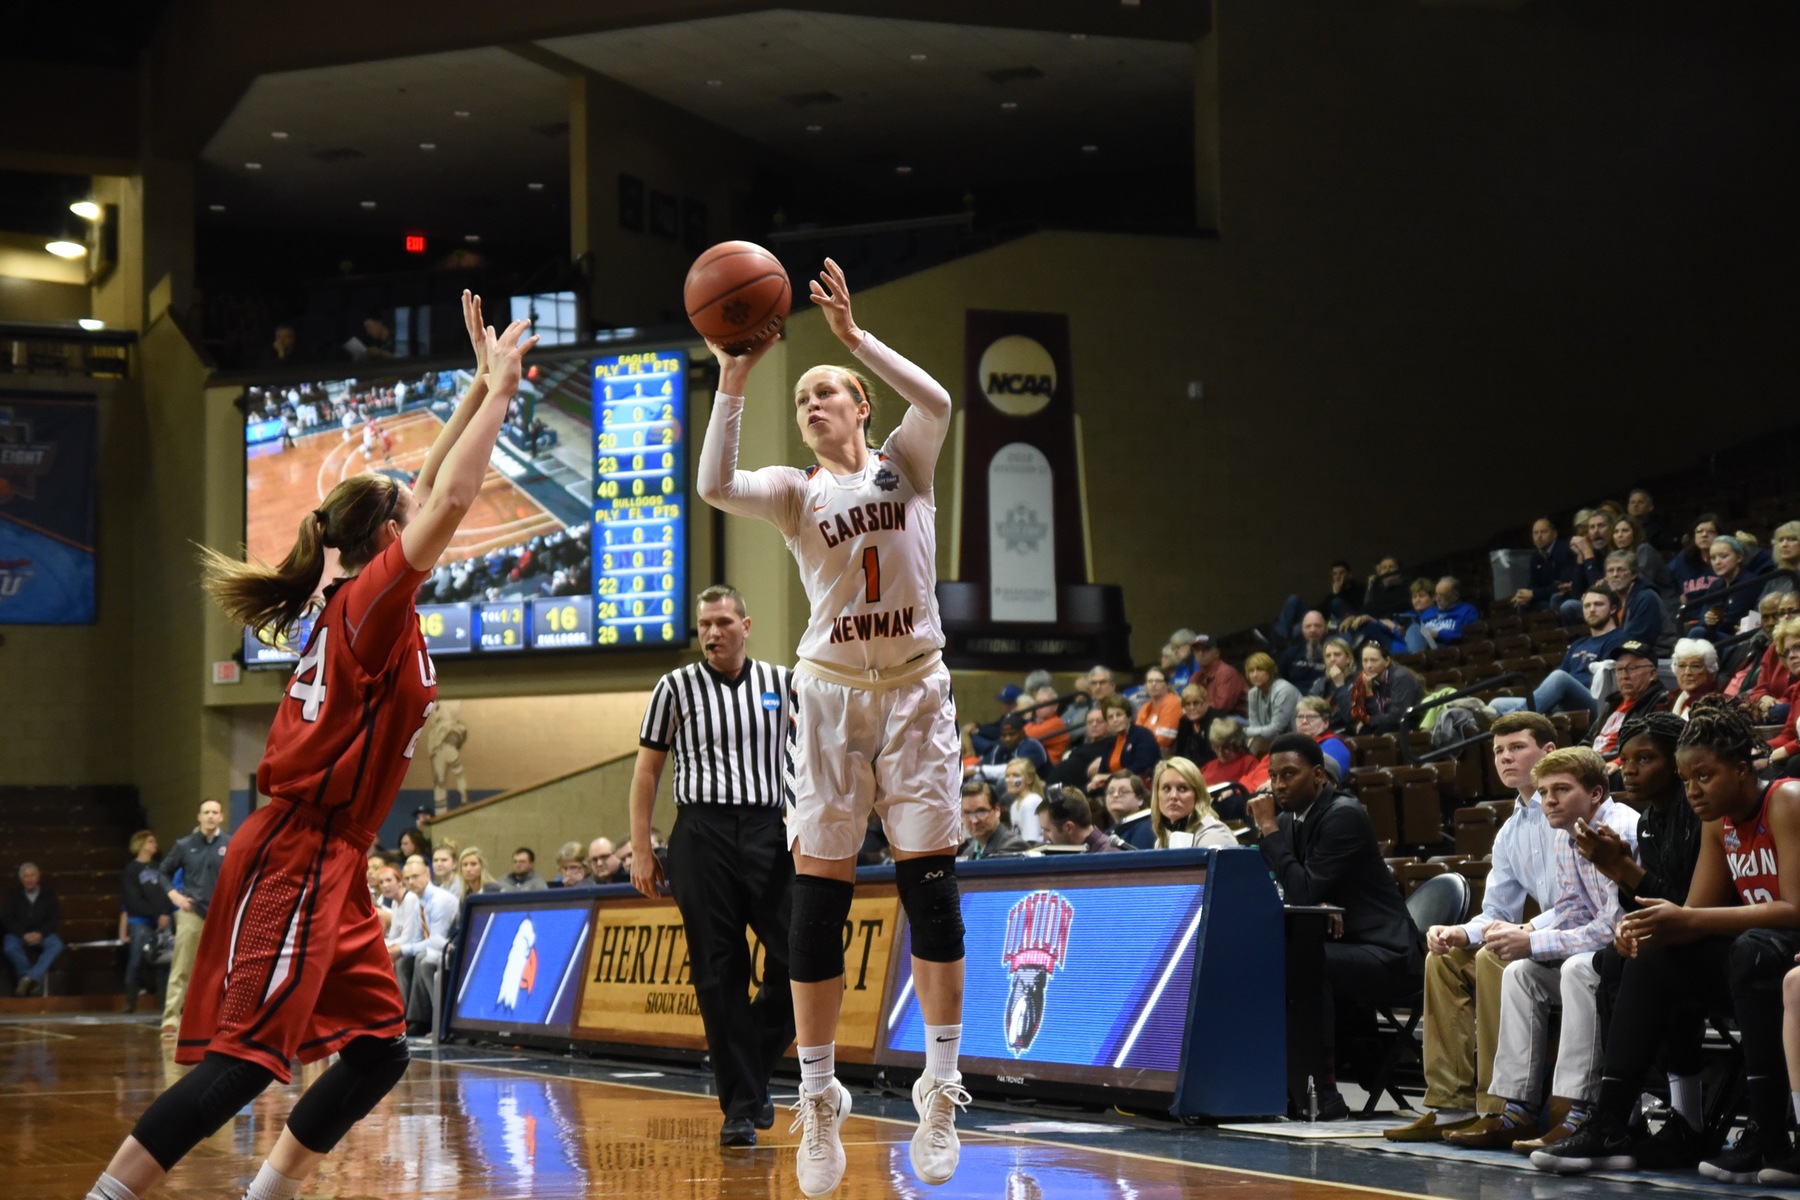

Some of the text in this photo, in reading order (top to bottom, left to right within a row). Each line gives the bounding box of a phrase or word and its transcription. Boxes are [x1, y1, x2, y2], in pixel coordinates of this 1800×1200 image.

[595, 358, 679, 378] PLY FL PTS
[619, 352, 656, 365] EAGLES
[604, 380, 673, 400] 1 1 4
[987, 372, 1052, 396] NCAA
[603, 403, 673, 425] 2 0 2
[598, 427, 673, 450] 20 0 2
[1, 450, 45, 465] EIGHT
[598, 451, 674, 474] 23 0 0
[597, 476, 674, 498] 40 0 0
[612, 494, 663, 509] BULLDOGS
[595, 504, 679, 523] PLY FL PTS
[604, 525, 673, 545] 1 0 2
[818, 502, 906, 548] CARSON
[603, 549, 673, 570] 3 0 2
[598, 573, 674, 595] 22 0 0
[862, 546, 880, 604] 1
[546, 606, 578, 631] 16
[598, 598, 674, 619] 24 0 0
[598, 622, 674, 644] 25 1 5
[830, 607, 915, 644] NEWMAN
[481, 629, 516, 645] FLS 3
[537, 632, 587, 645] BULLDOGS
[1003, 890, 1074, 972] UNION
[593, 925, 696, 985] HERITA
[645, 992, 701, 1016] SIOUX FALL
